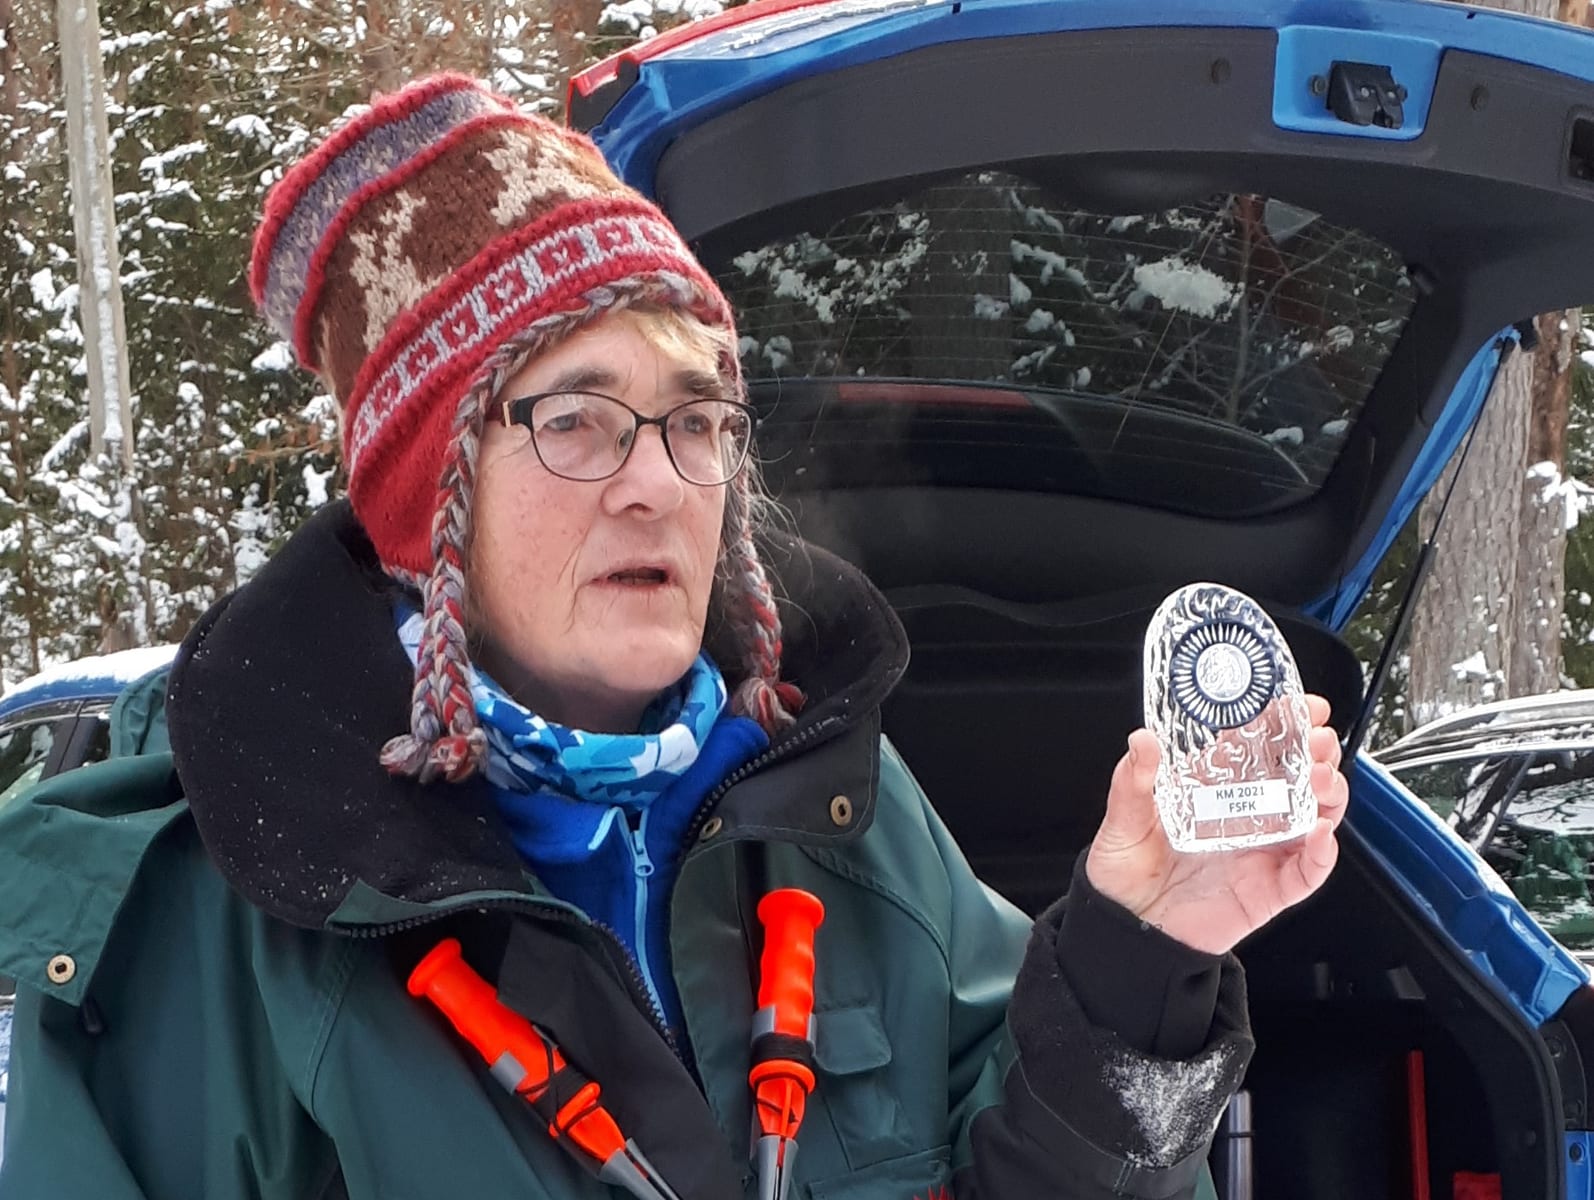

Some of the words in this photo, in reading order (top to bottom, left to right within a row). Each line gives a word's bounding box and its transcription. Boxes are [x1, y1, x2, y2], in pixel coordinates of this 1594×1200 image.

[1215, 788, 1234, 800] KM
[1237, 786, 1265, 798] 2021
[1229, 801, 1257, 813] FSFK
